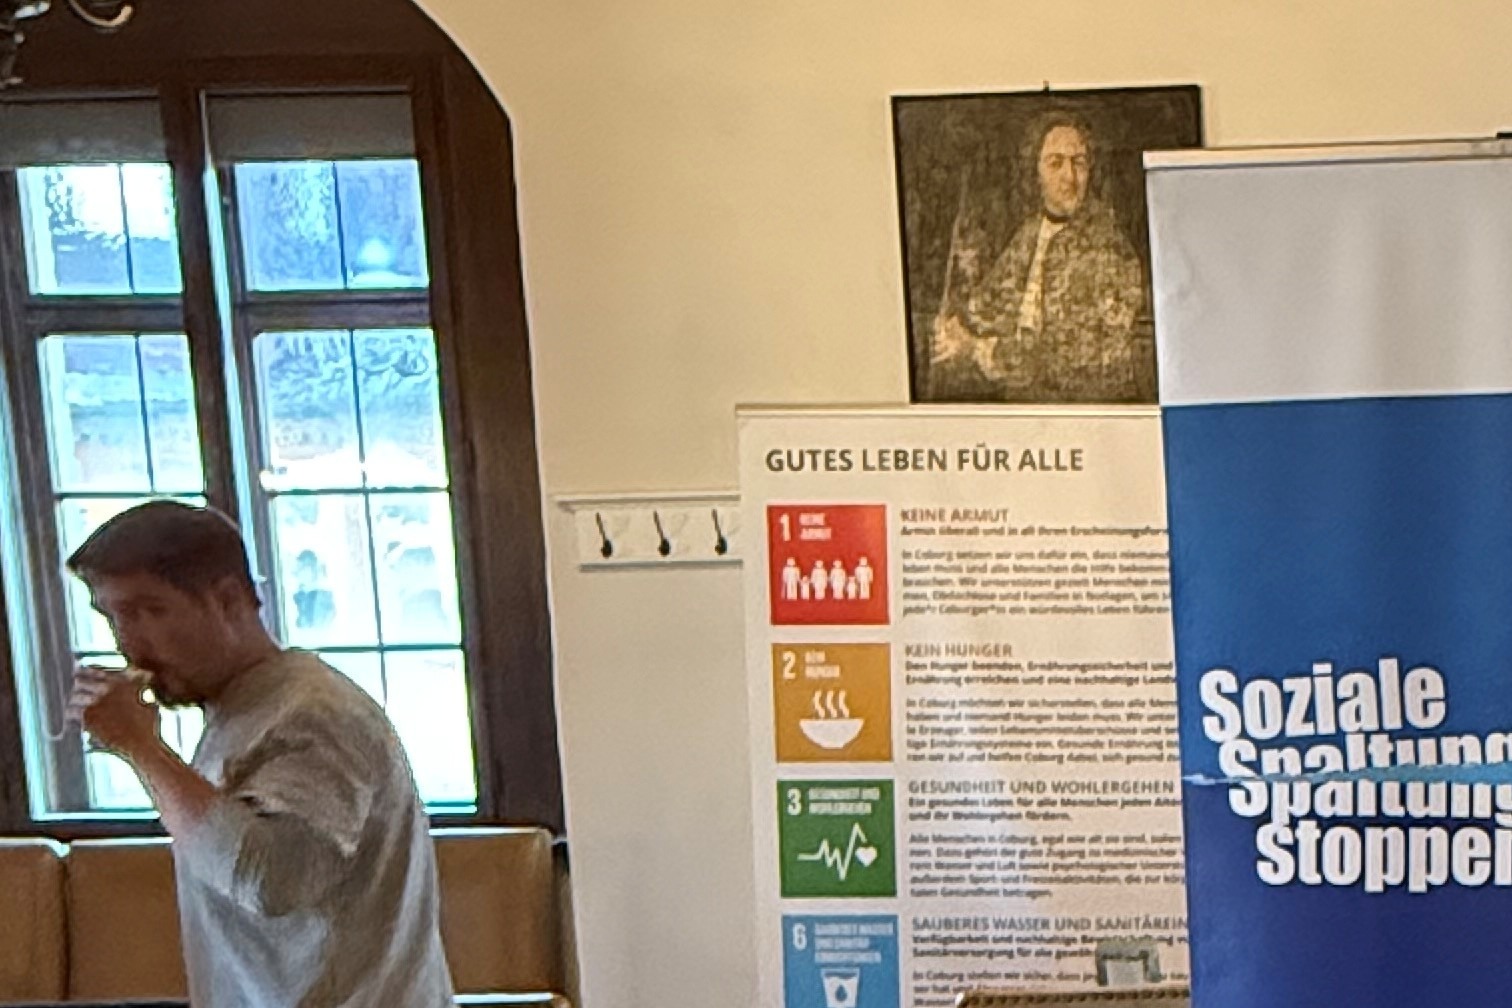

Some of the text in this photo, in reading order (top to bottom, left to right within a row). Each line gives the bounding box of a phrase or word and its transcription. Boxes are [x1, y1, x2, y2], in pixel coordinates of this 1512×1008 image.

[766, 443, 1084, 472] GUTES LEBEN FÜR ALLE
[780, 513, 791, 541] 1
[900, 508, 1009, 523] KEINE ARMUT
[905, 643, 1013, 657] KEIN HUNGER
[783, 650, 796, 680] 2
[1200, 657, 1446, 743] Soziale
[908, 780, 1174, 794] GESUNDHEIT UND WOHLERGEHEN
[787, 788, 801, 815] 3
[792, 922, 807, 950] 6
[912, 917, 989, 931] SAUBERES
[993, 917, 1050, 931] WASSER
[1054, 917, 1091, 930] UND
